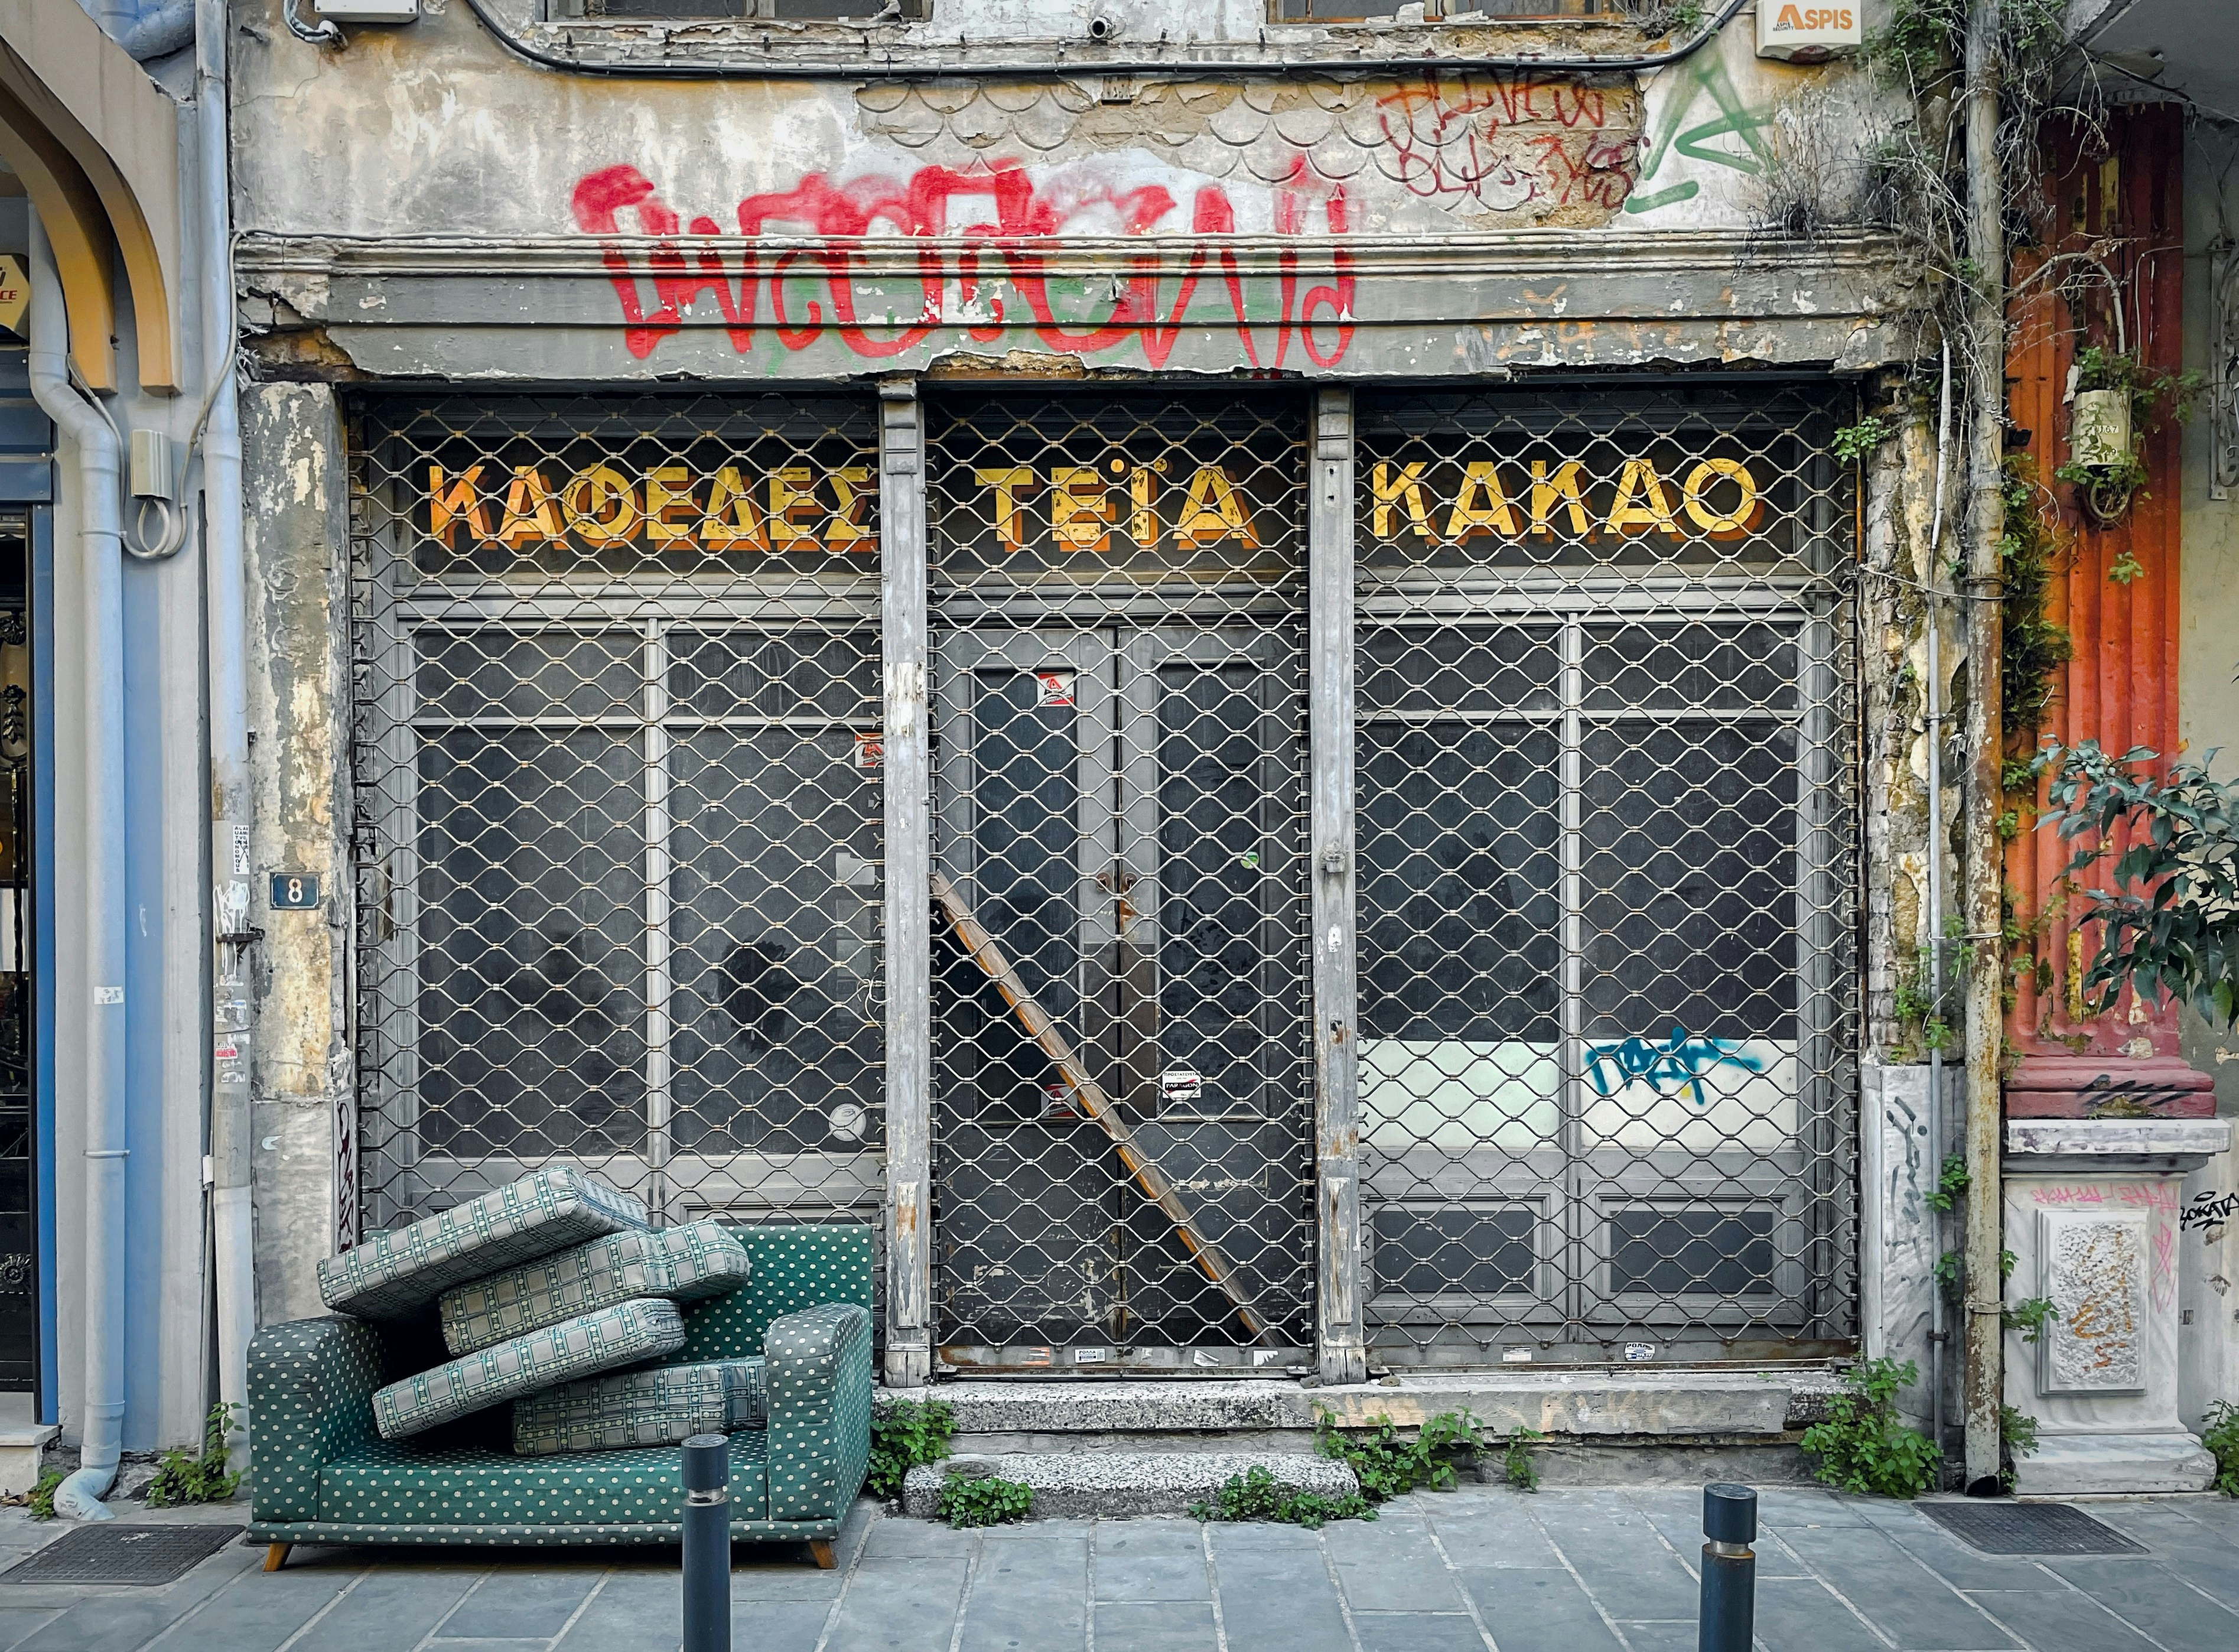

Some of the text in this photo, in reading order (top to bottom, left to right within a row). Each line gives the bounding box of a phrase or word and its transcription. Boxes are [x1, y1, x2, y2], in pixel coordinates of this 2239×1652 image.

[1777, 4, 1853, 30] ASPIS
[429, 463, 872, 544] ΚΑΦΕΔΕΣ
[1371, 457, 1758, 538] ΚΑΚΑΟ
[288, 878, 302, 903] 8
